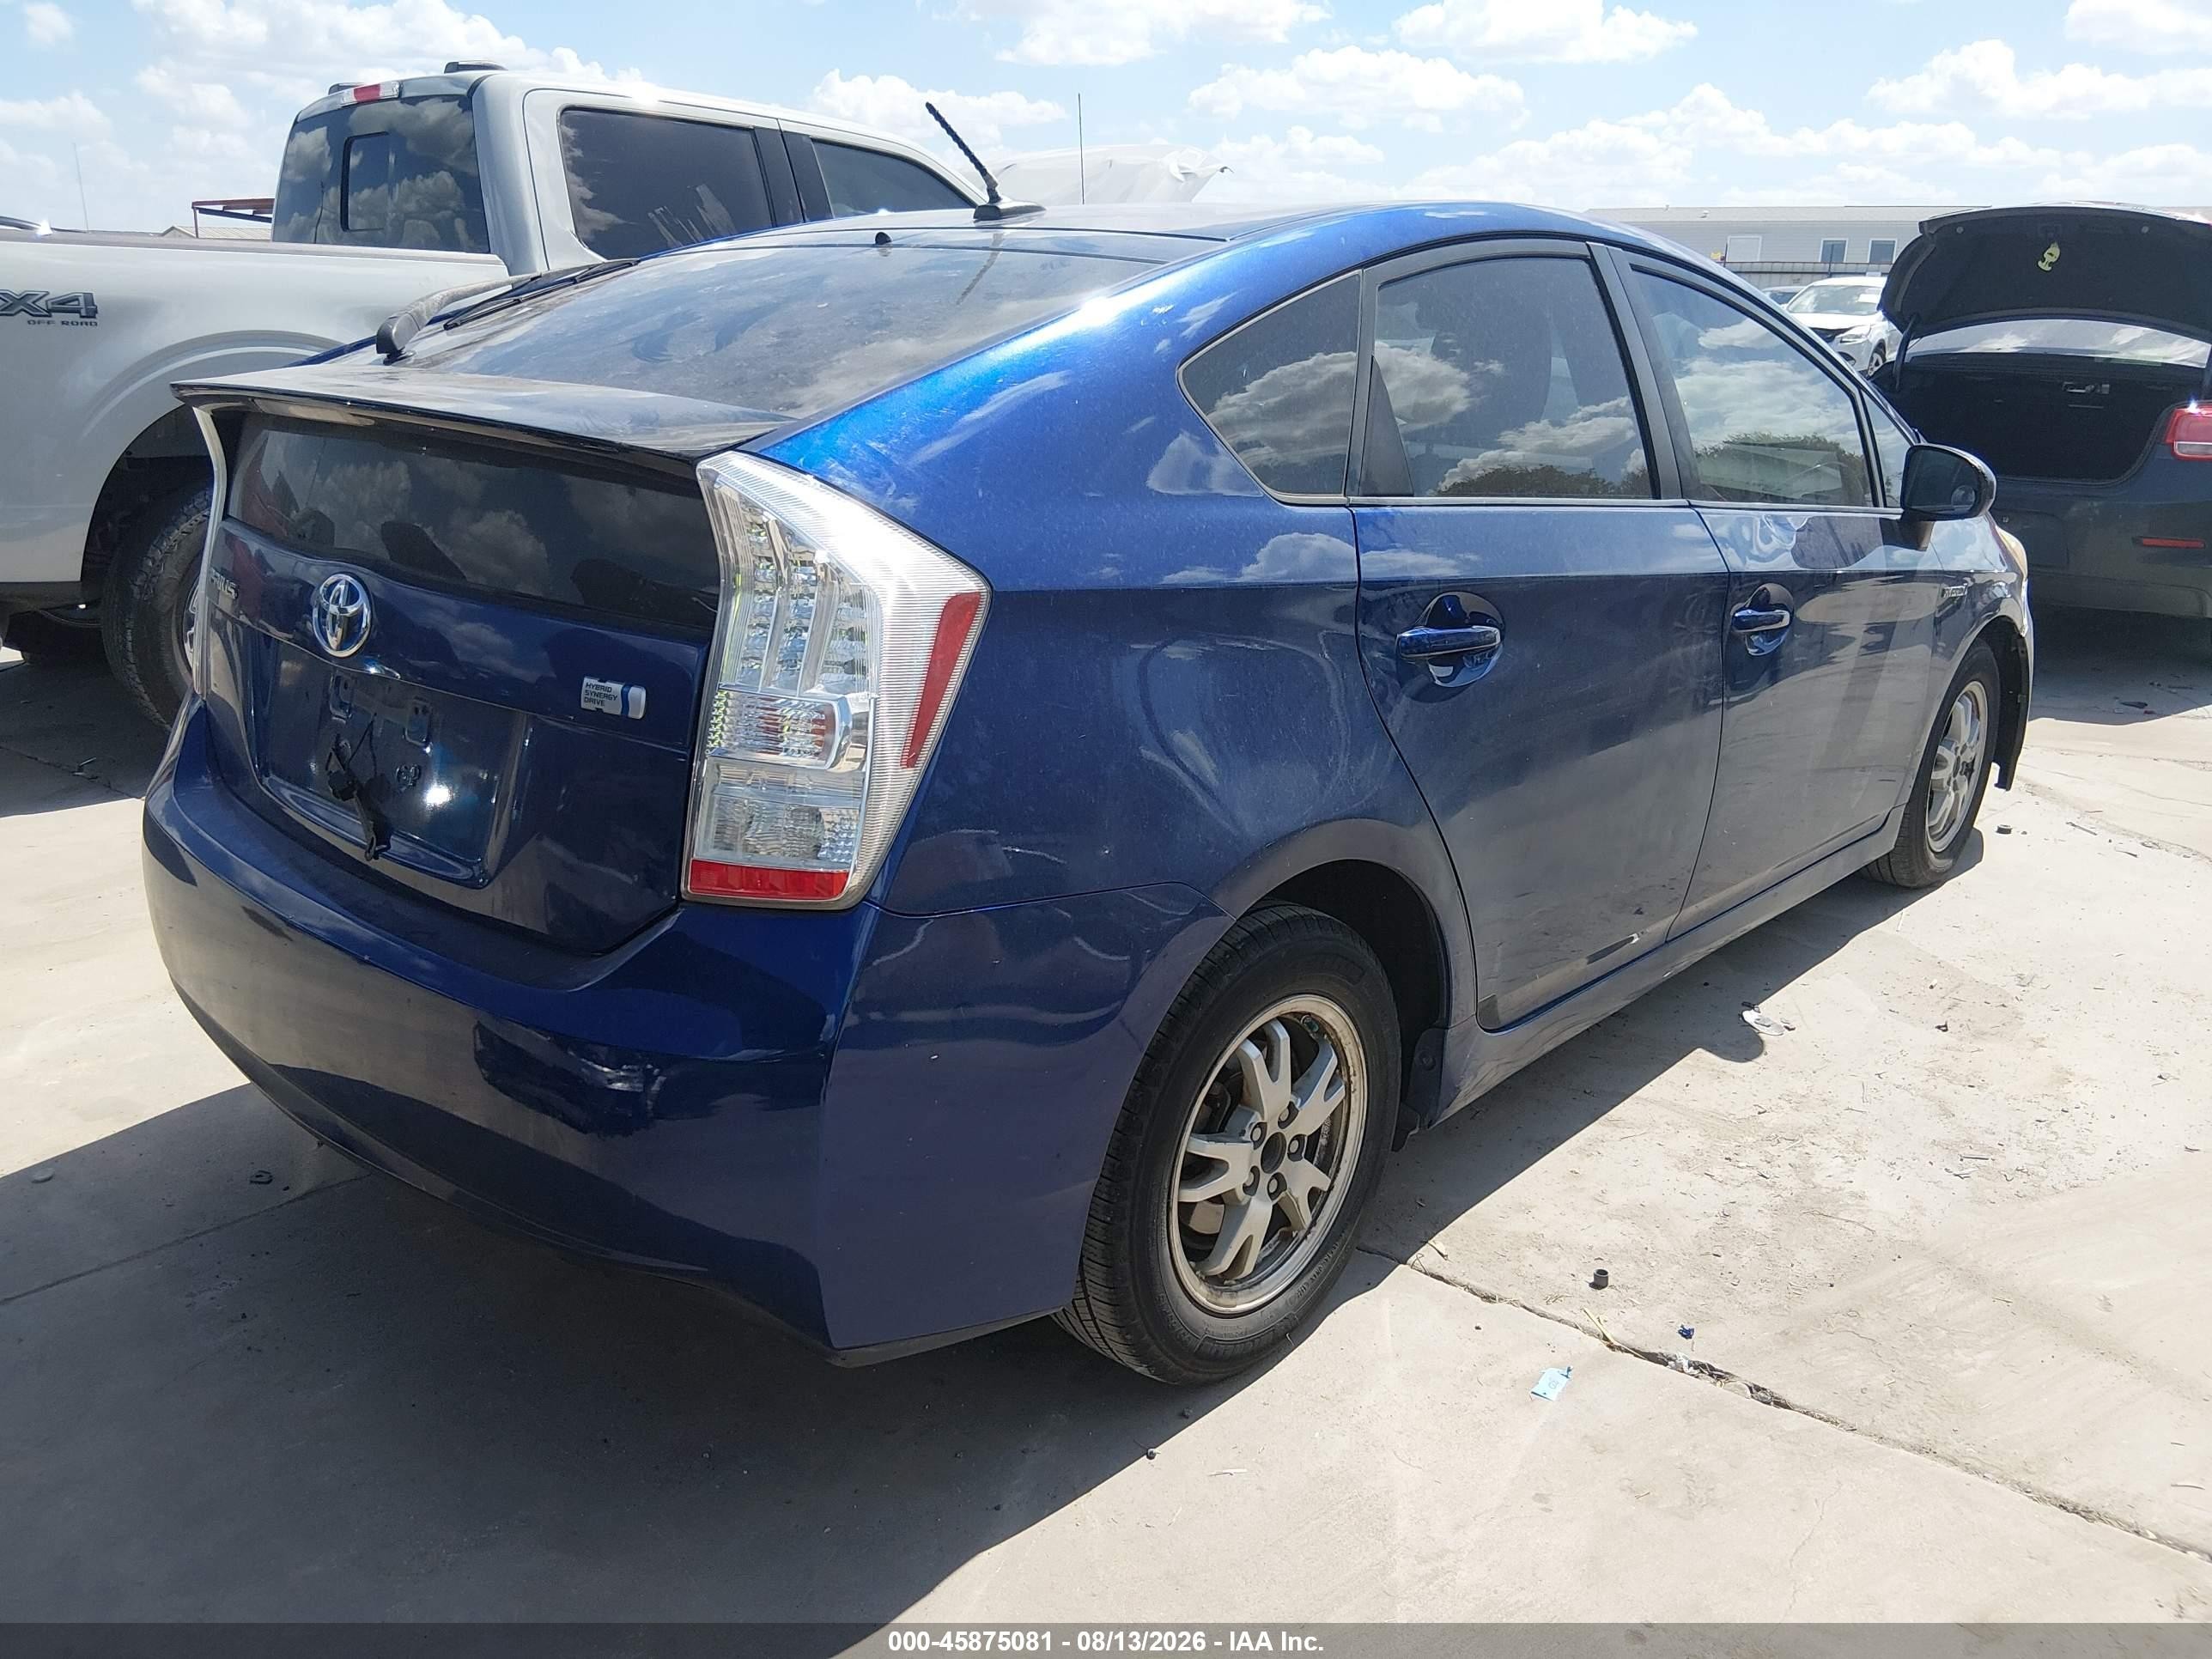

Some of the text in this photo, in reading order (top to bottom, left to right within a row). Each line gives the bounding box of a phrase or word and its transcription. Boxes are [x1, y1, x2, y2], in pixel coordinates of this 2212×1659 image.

[585, 682, 612, 693] HYBRID
[584, 690, 618, 701] SYNERGY
[583, 696, 605, 707] DRIVE
